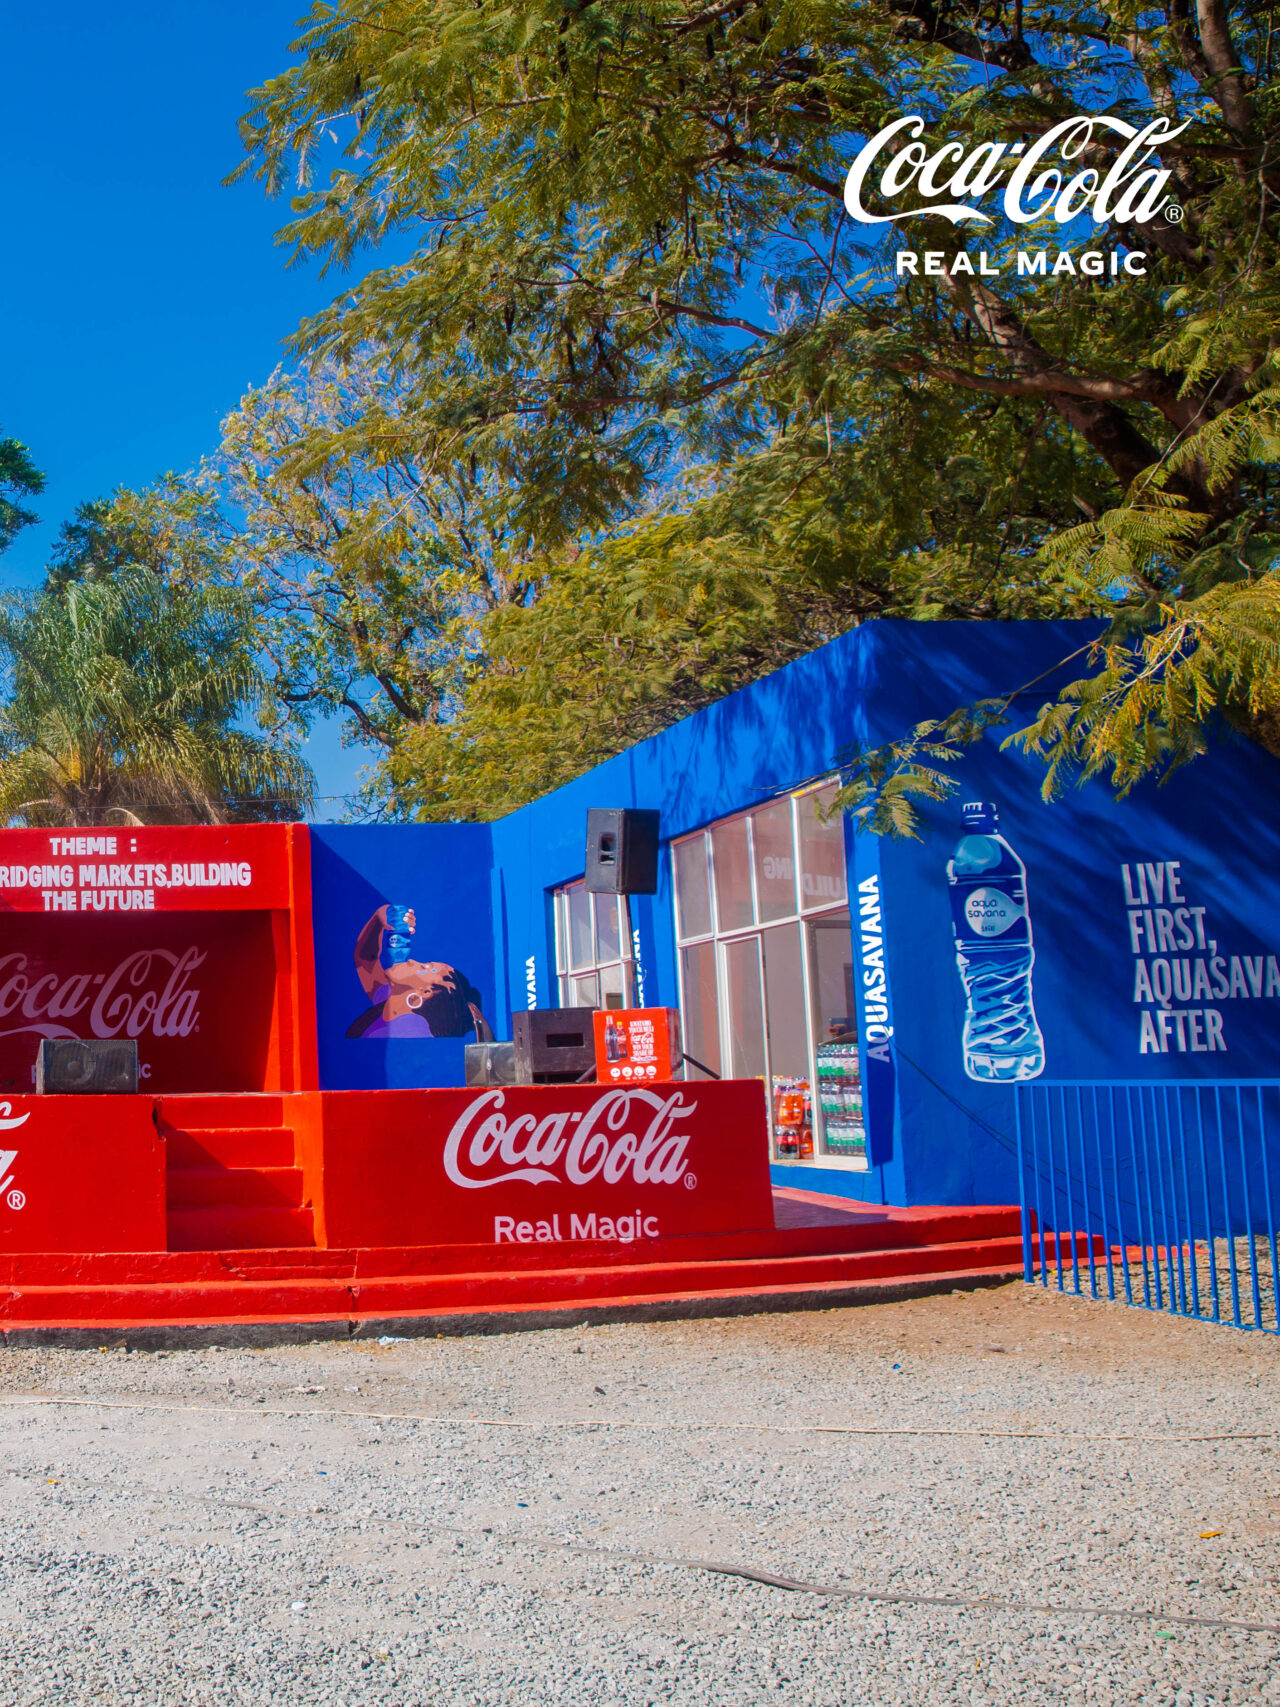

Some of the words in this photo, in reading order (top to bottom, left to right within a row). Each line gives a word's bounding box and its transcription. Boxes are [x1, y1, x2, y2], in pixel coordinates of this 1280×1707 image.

[49, 836, 117, 856] THEME
[42, 890, 77, 911] THE
[81, 889, 155, 911] FUTURE
[1122, 861, 1186, 906] LIVE
[967, 910, 1006, 918] savana
[971, 899, 997, 909] aqua
[1127, 906, 1218, 957] FIRST,
[858, 874, 894, 1064] AQUASAVANA
[1139, 1008, 1228, 1054] AFTER
[443, 1088, 699, 1190] Coca-Cola
[494, 1213, 562, 1243] Real
[570, 1209, 659, 1244] Magic
